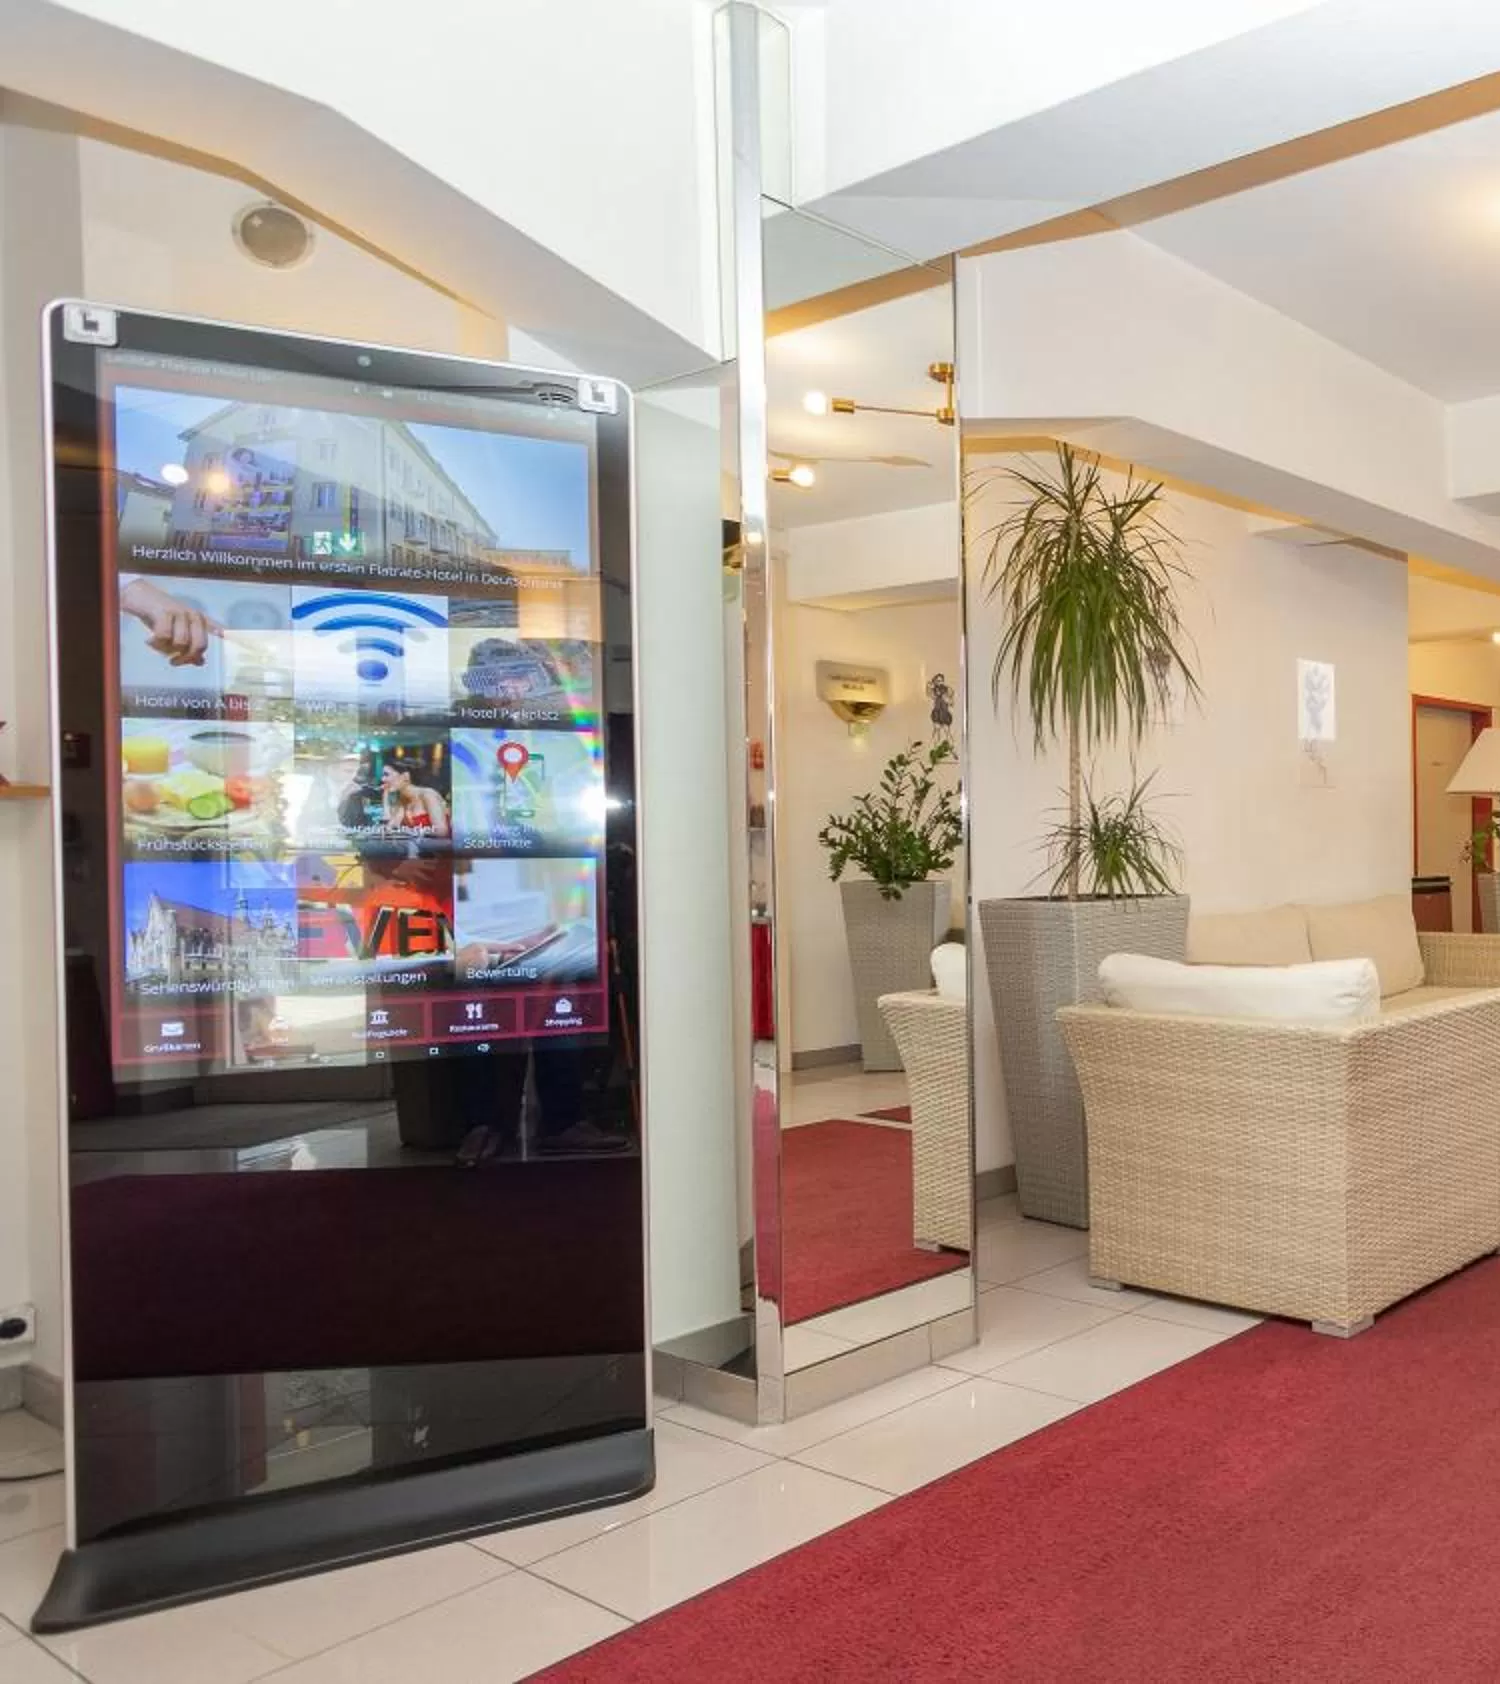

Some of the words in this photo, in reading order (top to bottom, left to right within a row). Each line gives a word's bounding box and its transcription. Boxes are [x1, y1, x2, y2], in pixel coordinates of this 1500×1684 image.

[132, 545, 197, 562] Herzlich
[200, 550, 293, 569] Willkommen
[135, 695, 177, 708] Hotel
[181, 698, 211, 710] von
[461, 706, 497, 720] Hotel
[467, 966, 537, 980] Bewertung
